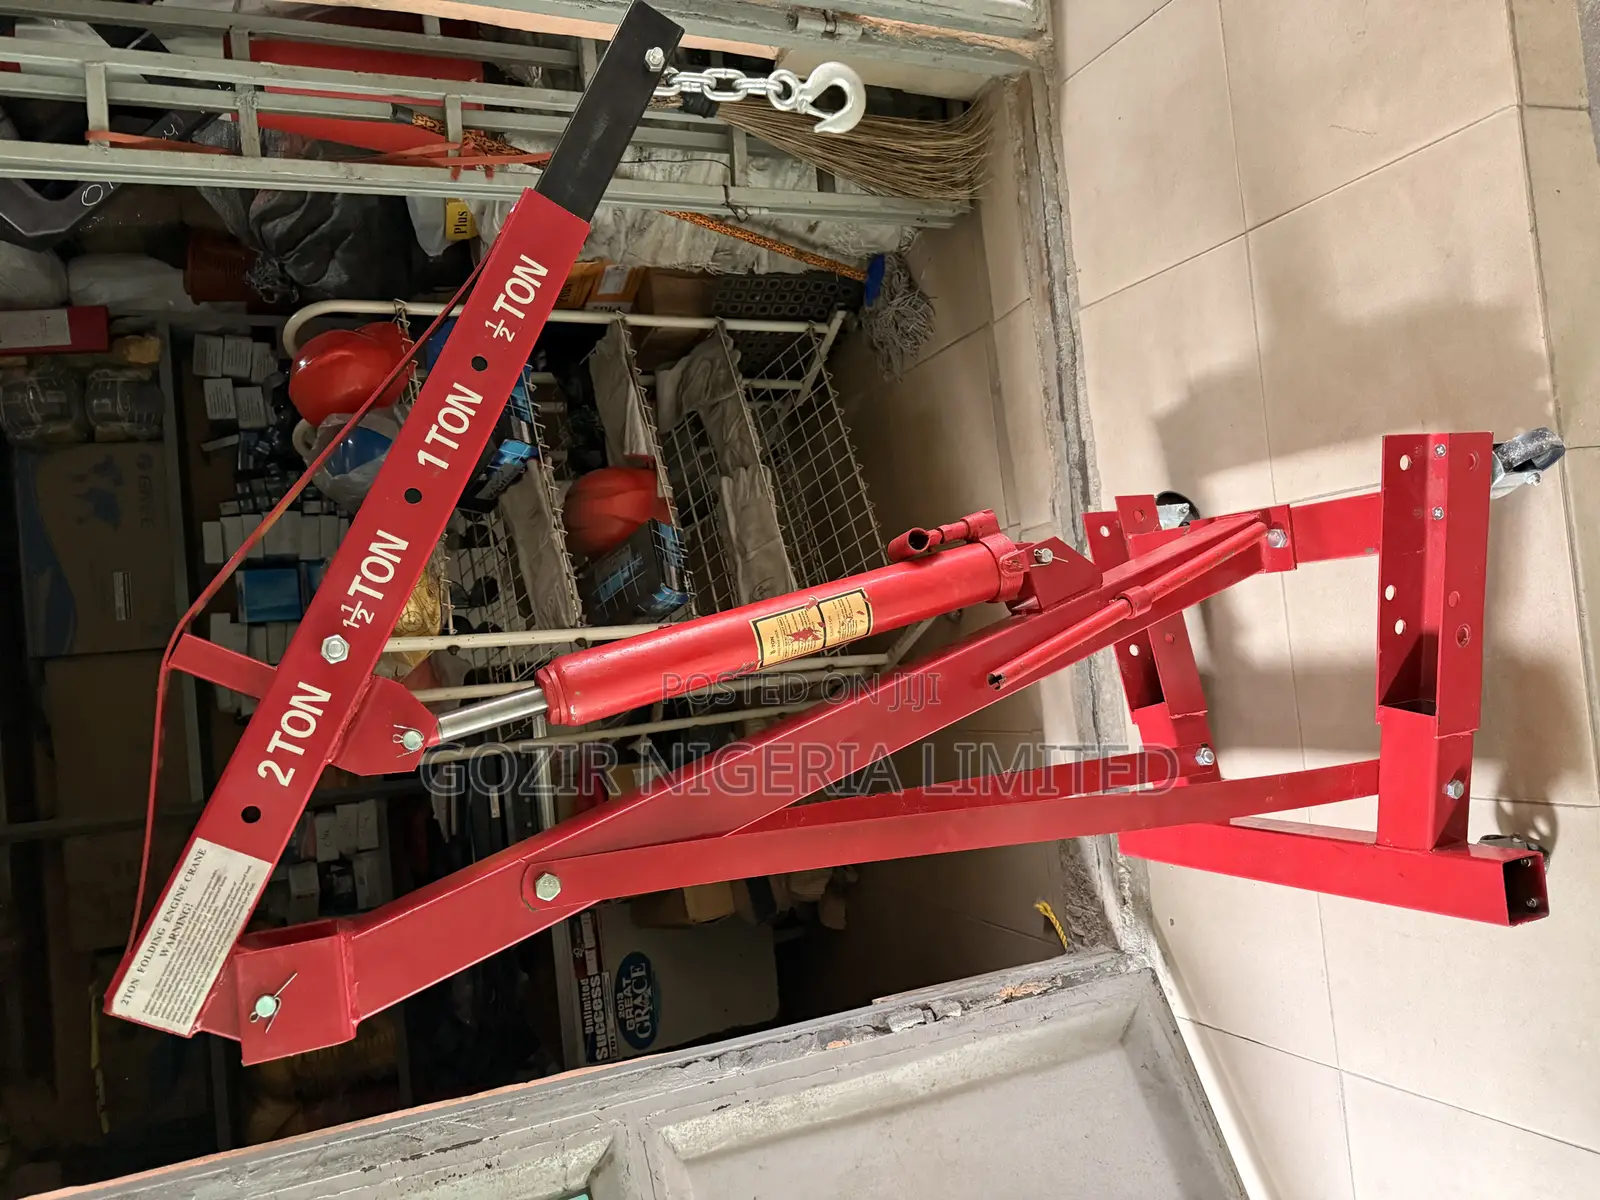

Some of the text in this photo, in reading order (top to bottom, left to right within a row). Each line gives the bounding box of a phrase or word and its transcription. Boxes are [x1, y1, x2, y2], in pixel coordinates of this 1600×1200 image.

[454, 211, 468, 235] Plus
[492, 254, 549, 320] TON
[417, 382, 484, 470] 1 TON
[347, 529, 409, 601] TON
[257, 681, 332, 787] 2 TON
[120, 848, 207, 1006] 2TON FOLDING ENGINE CRANE
[159, 902, 194, 958] WARNING!
[580, 978, 594, 1034] Unlimited
[590, 975, 609, 1060] Success
[616, 992, 625, 1019] 2013
[622, 977, 636, 1031] GREAT
[630, 963, 652, 1038] GRACE
